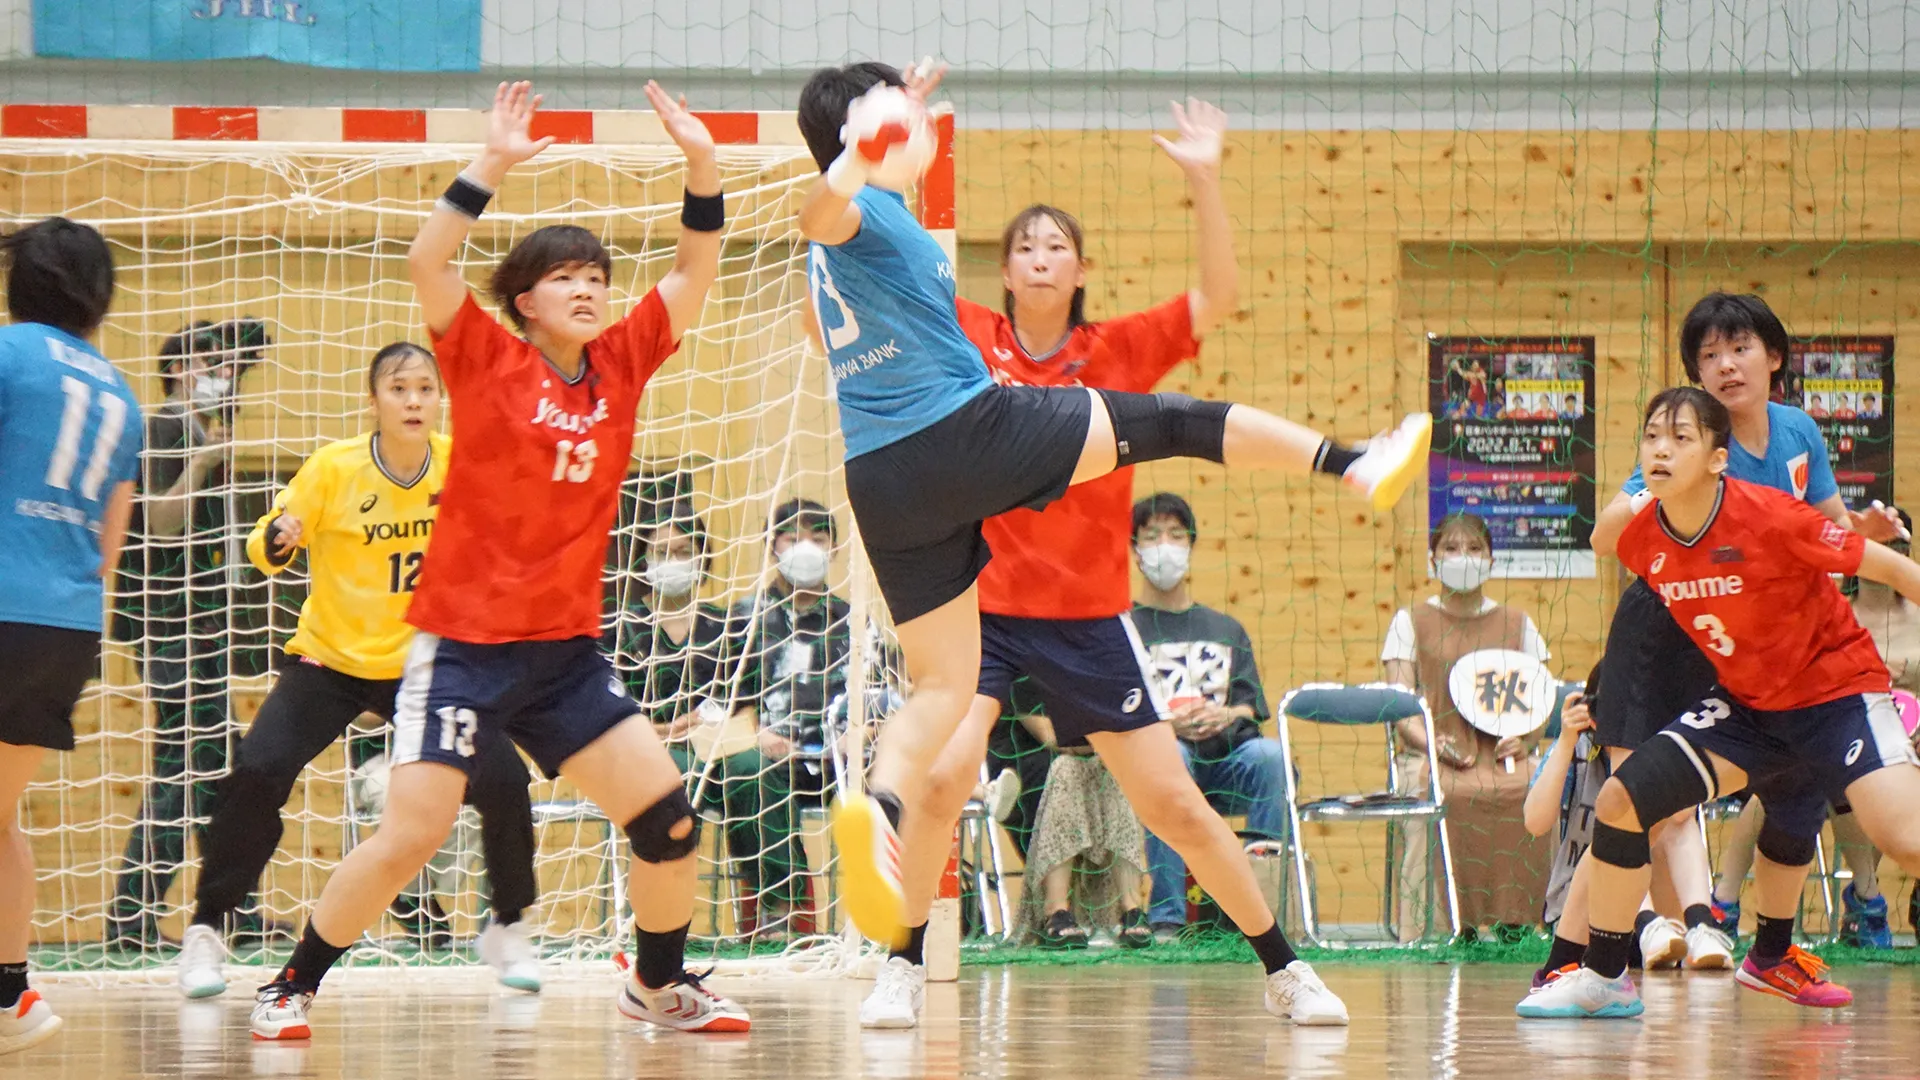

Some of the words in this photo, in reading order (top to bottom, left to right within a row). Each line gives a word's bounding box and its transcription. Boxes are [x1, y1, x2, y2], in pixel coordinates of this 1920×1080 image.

[858, 339, 902, 369] BANK
[45, 375, 127, 501] 11
[552, 439, 599, 483] 13
[388, 552, 424, 594] 12
[1658, 574, 1744, 608] youme
[1692, 613, 1736, 657] 3
[1474, 670, 1532, 714] 秋
[1680, 697, 1731, 730] 3
[435, 706, 478, 758] 13
